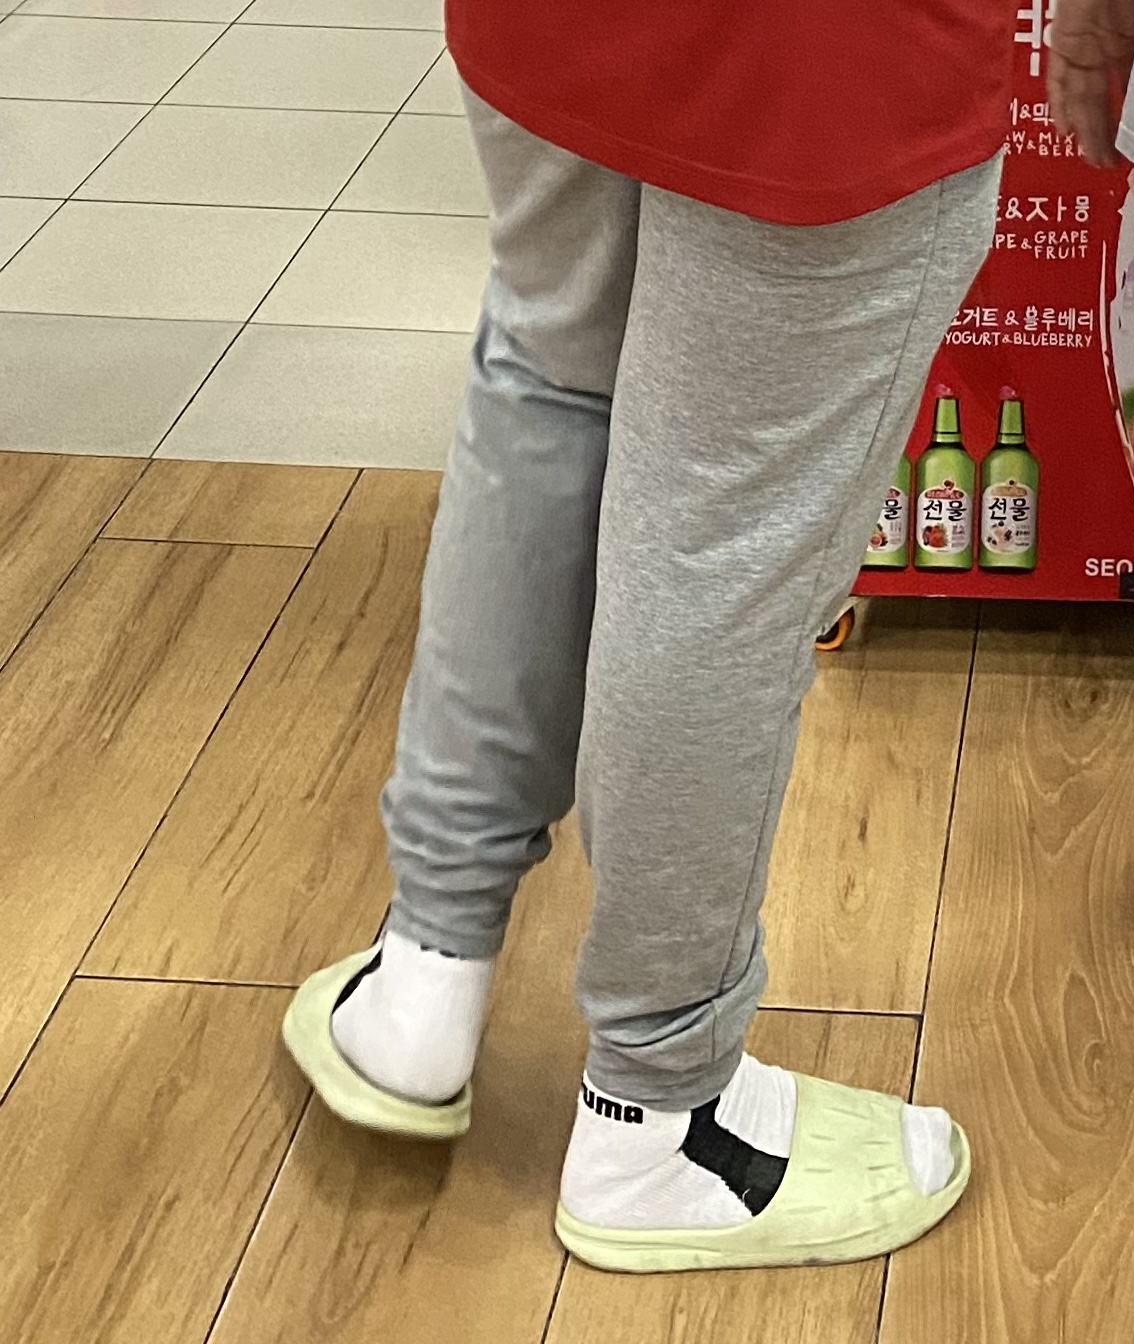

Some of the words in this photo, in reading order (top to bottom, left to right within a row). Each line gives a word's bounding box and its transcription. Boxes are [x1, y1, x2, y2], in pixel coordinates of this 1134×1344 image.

[990, 234, 1017, 250] PE
[1034, 230, 1089, 245] GRAPE
[1034, 245, 1088, 260] FRUIT
[1005, 310, 1020, 326] &
